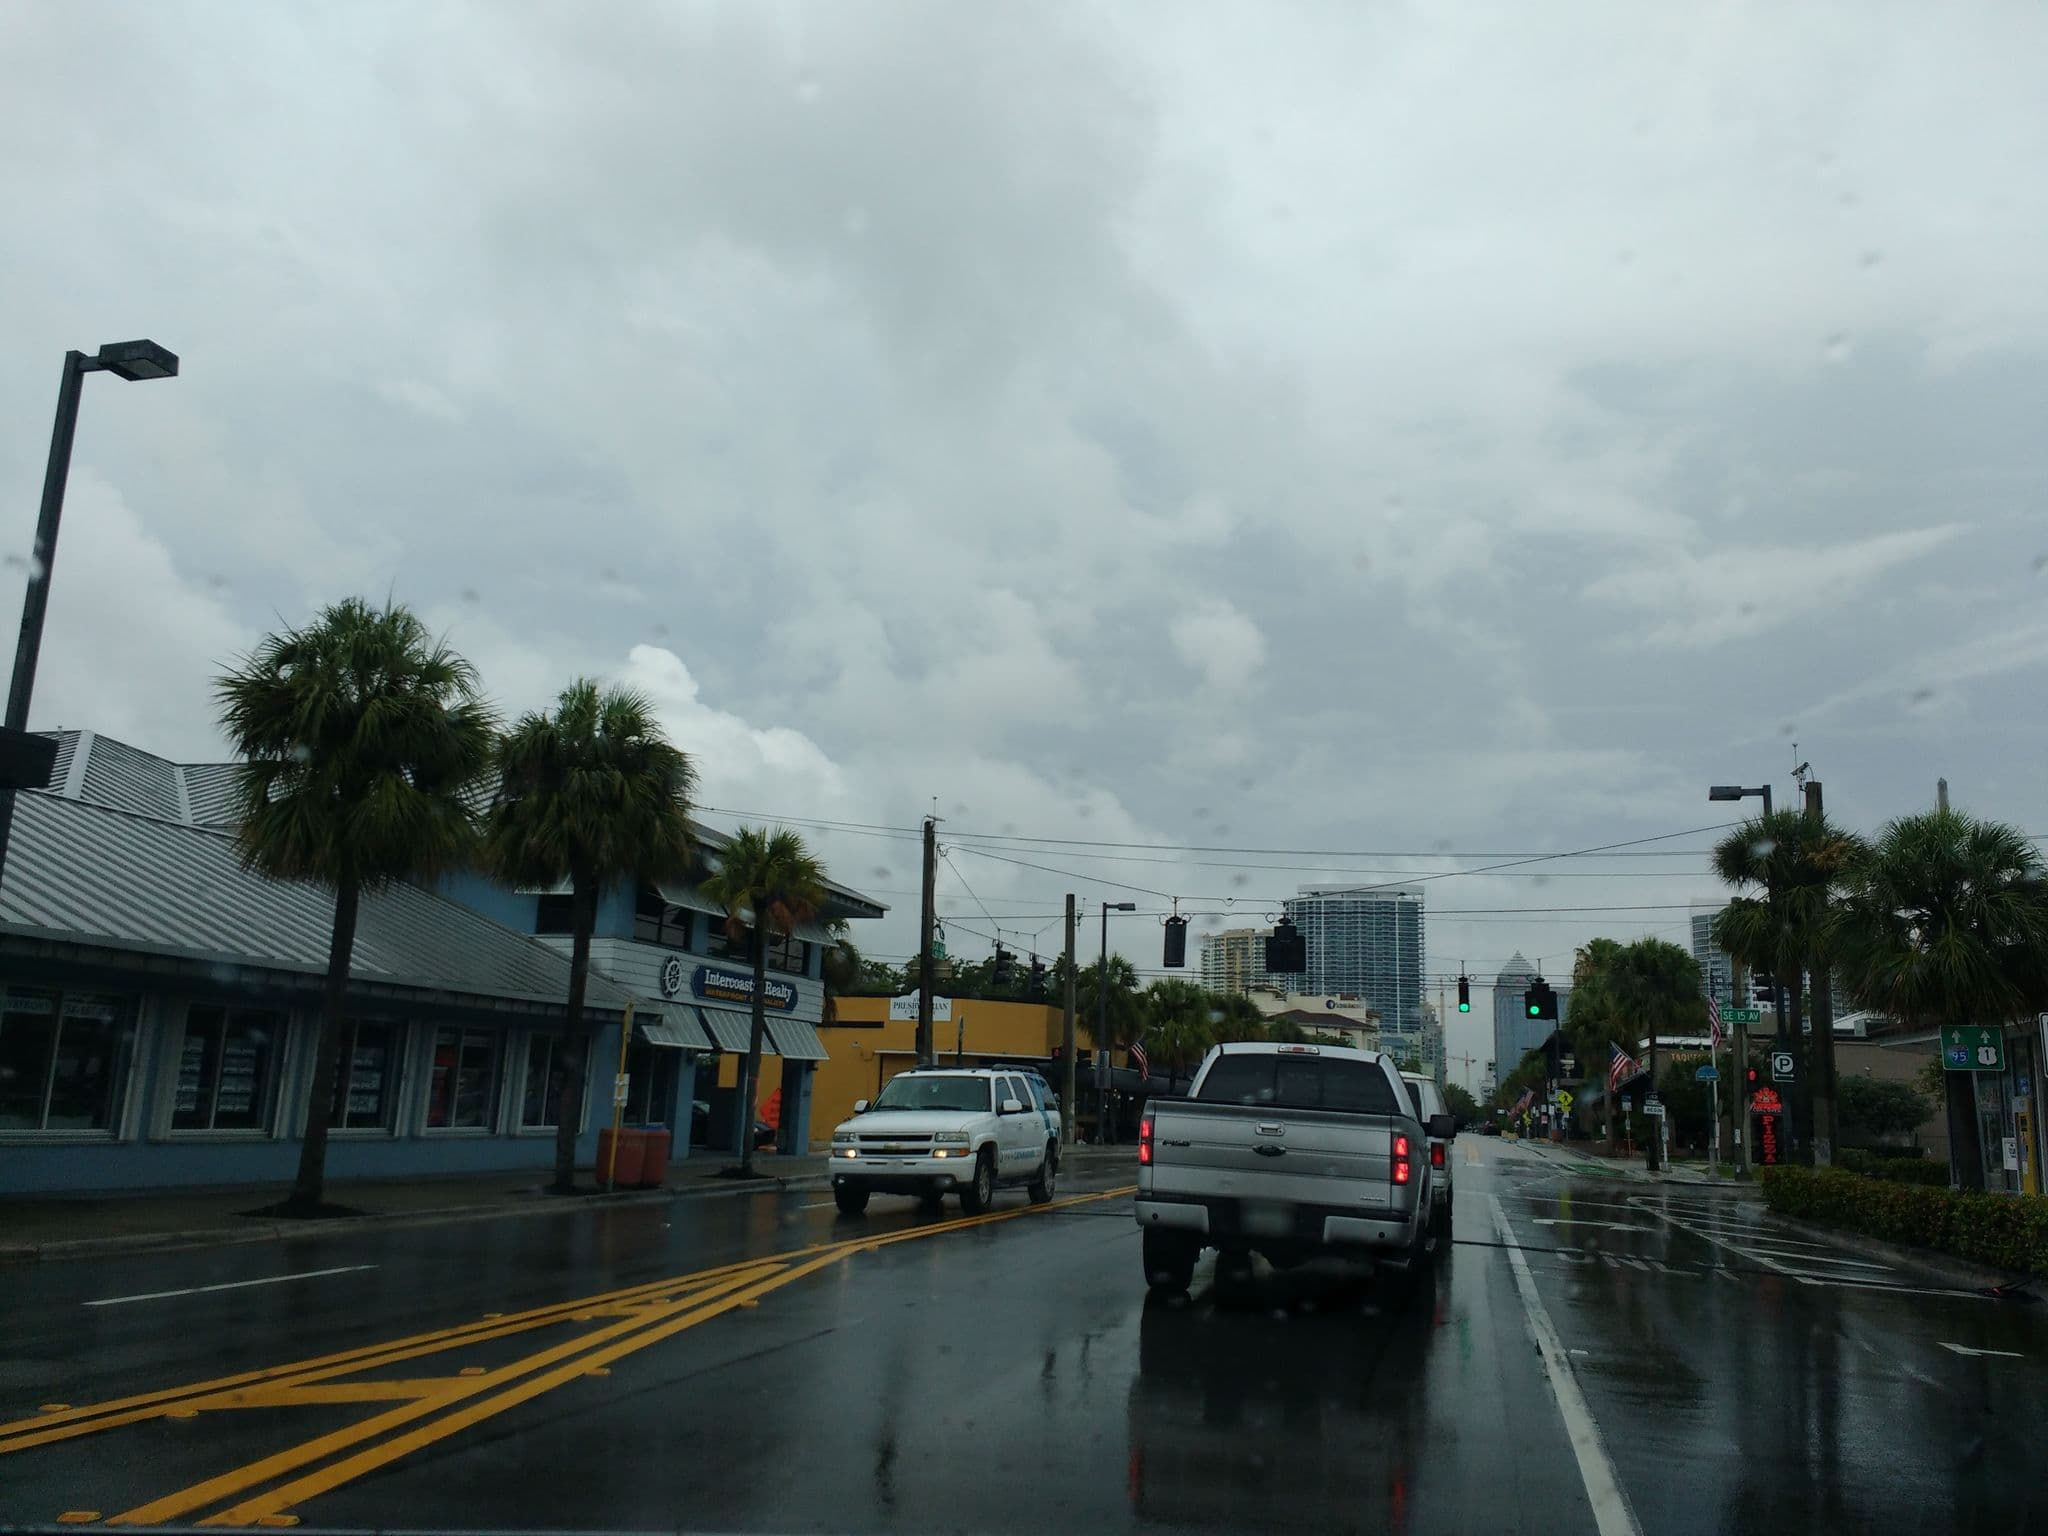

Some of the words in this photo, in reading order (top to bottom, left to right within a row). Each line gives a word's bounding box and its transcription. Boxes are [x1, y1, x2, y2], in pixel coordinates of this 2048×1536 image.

[704, 969, 756, 992] Intercoast
[764, 981, 793, 1003] Realty
[1723, 1011, 1733, 1021] SE
[1737, 1011, 1746, 1021] 15
[1748, 1012, 1759, 1021] AV
[1952, 1051, 1967, 1062] 95
[1985, 1049, 1989, 1061] 1
[1780, 1058, 1790, 1070] P
